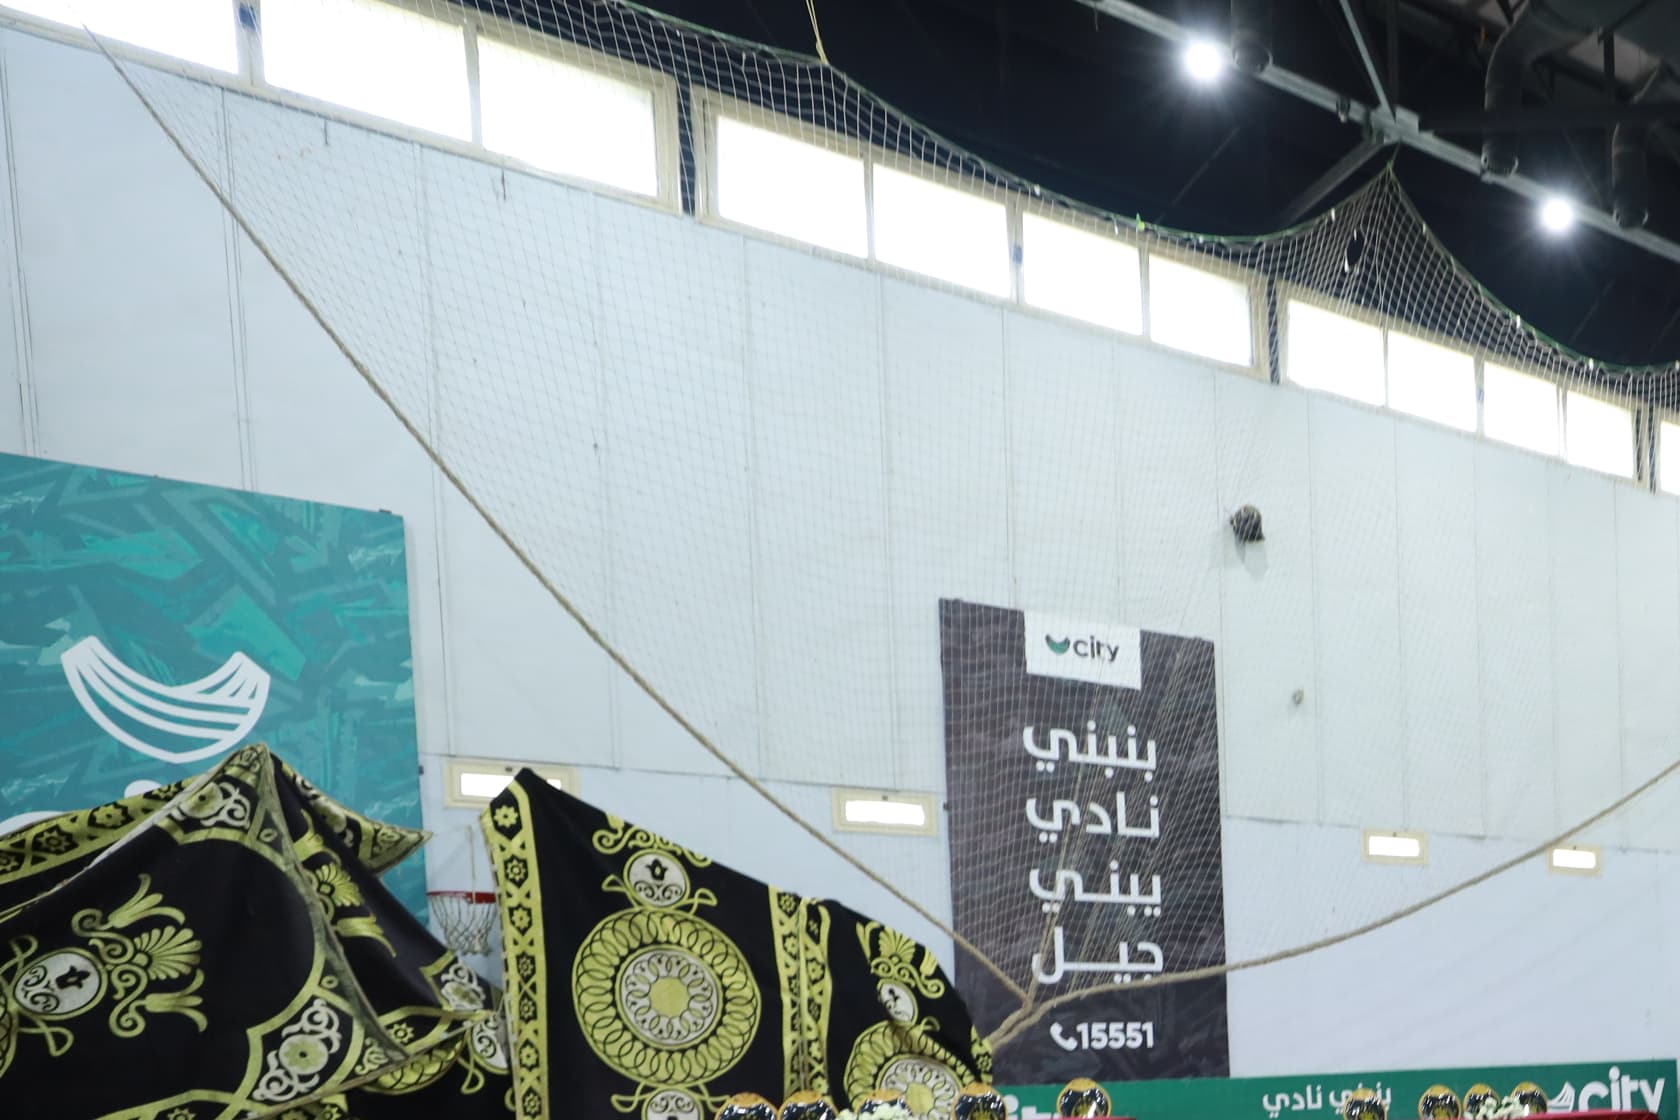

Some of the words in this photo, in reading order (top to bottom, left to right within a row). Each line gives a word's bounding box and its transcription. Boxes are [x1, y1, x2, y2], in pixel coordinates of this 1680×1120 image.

[1073, 636, 1119, 662] city
[1023, 720, 1157, 782] بنبني
[1025, 791, 1160, 843] نادي
[1029, 860, 1161, 917] يبني
[1032, 926, 1164, 984] جيل
[1075, 1021, 1154, 1049] 15551
[1262, 1084, 1322, 1118] نادي
[1578, 1065, 1665, 1115] city
